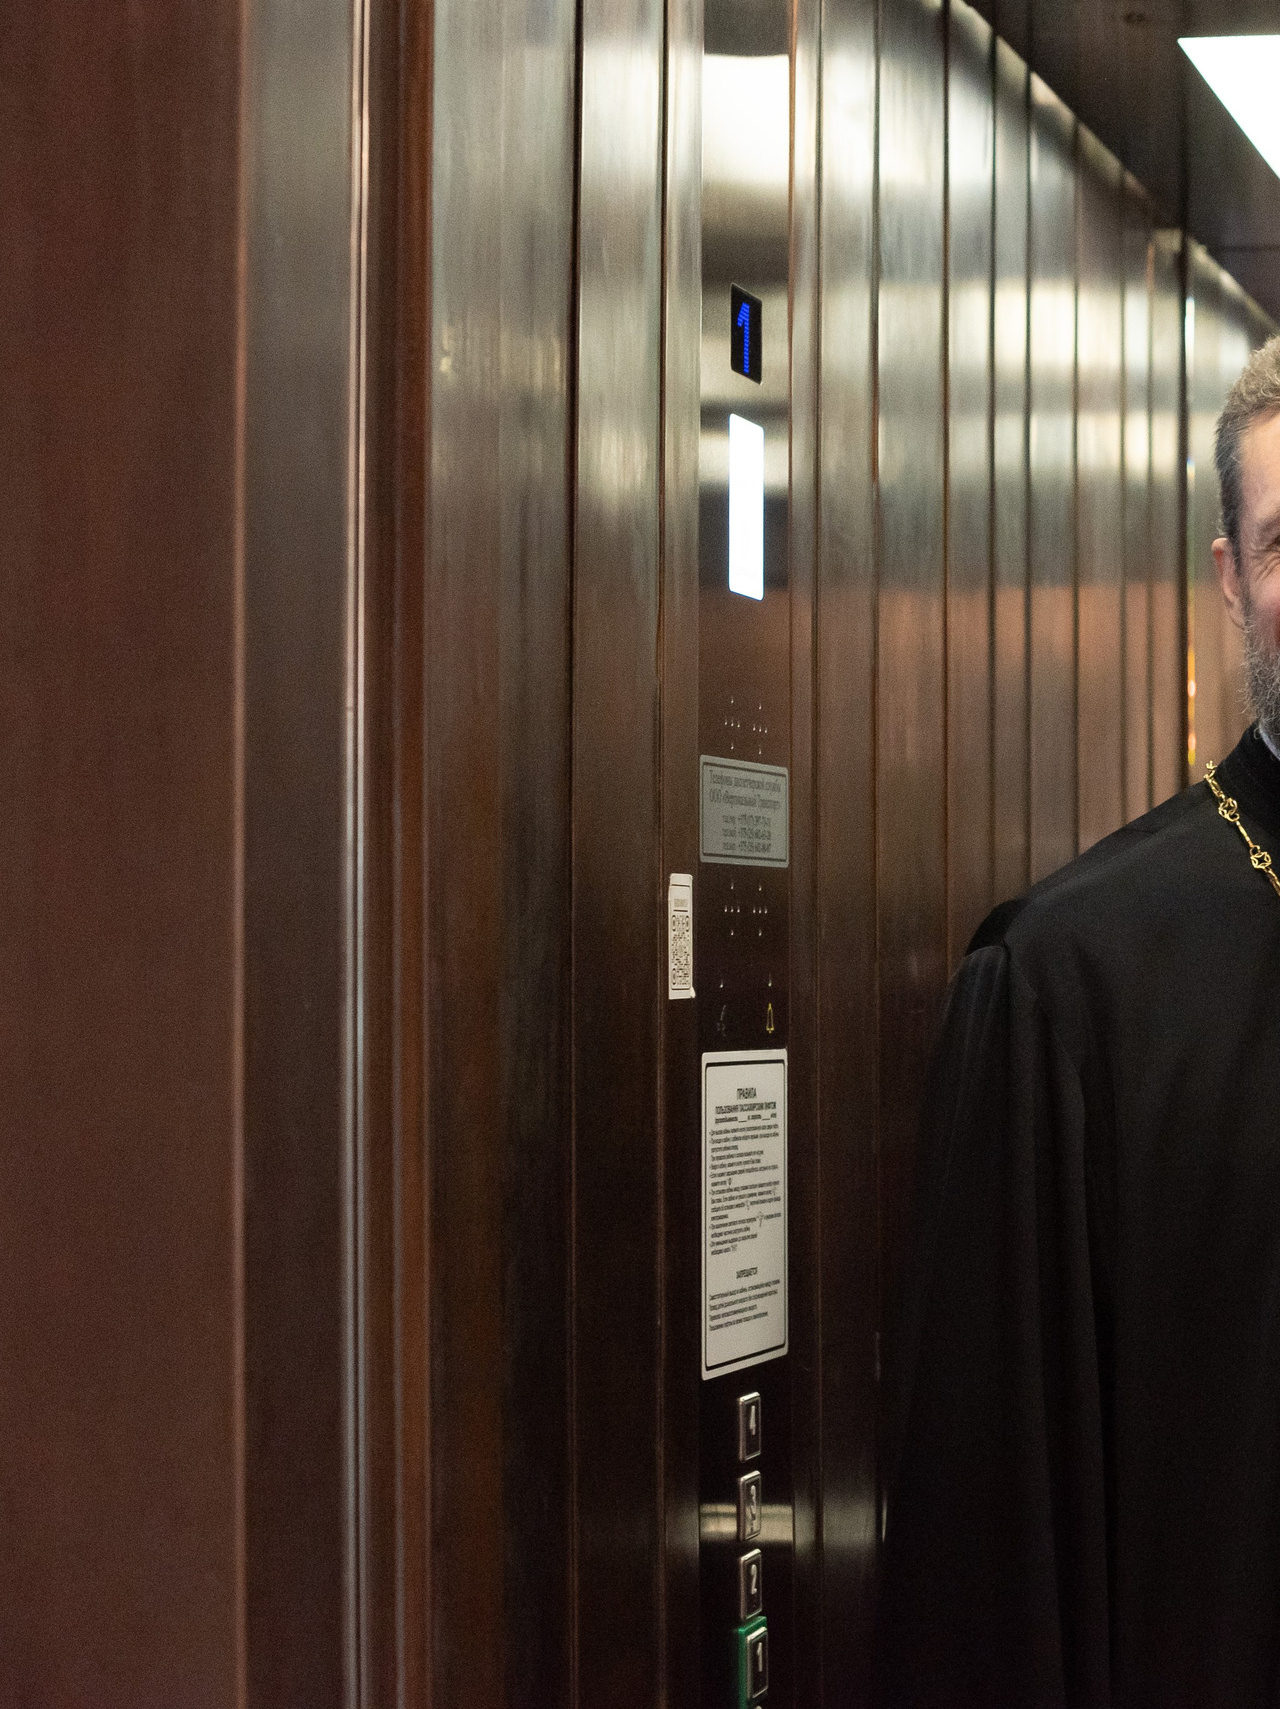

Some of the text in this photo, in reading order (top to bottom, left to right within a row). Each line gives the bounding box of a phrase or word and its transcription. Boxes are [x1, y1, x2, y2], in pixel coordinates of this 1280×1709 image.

[737, 302, 750, 374] 1
[737, 1087, 757, 1099] ПРАВИЛА
[750, 1405, 756, 1435] 4
[751, 1564, 758, 1595] 2
[757, 1642, 763, 1672] 1
